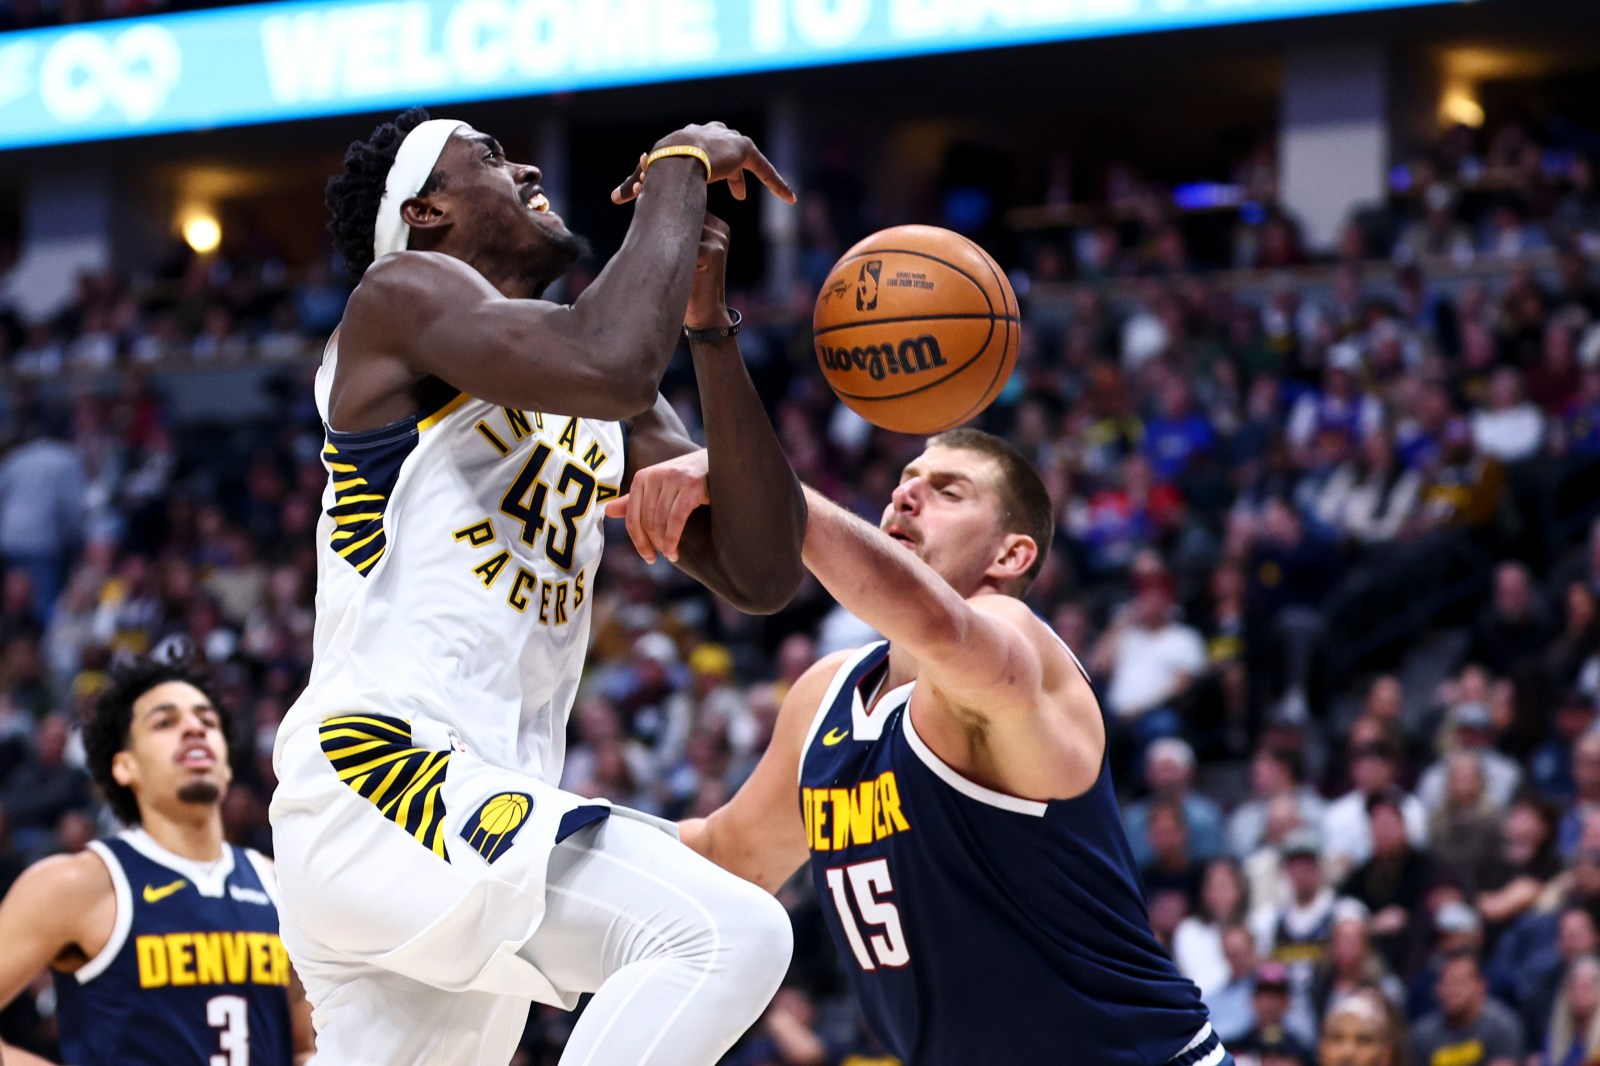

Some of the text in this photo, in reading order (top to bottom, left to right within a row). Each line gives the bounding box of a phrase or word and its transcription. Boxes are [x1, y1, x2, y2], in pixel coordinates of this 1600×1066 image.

[261, 0, 719, 102] WELCOME
[820, 334, 948, 381] Wilson
[475, 406, 619, 504] INANA
[499, 441, 597, 572] 43
[452, 517, 584, 627] PACERS
[802, 770, 911, 851] DENVER
[136, 932, 290, 989] DENVER
[825, 858, 911, 971] 15
[206, 994, 250, 1066] 3
